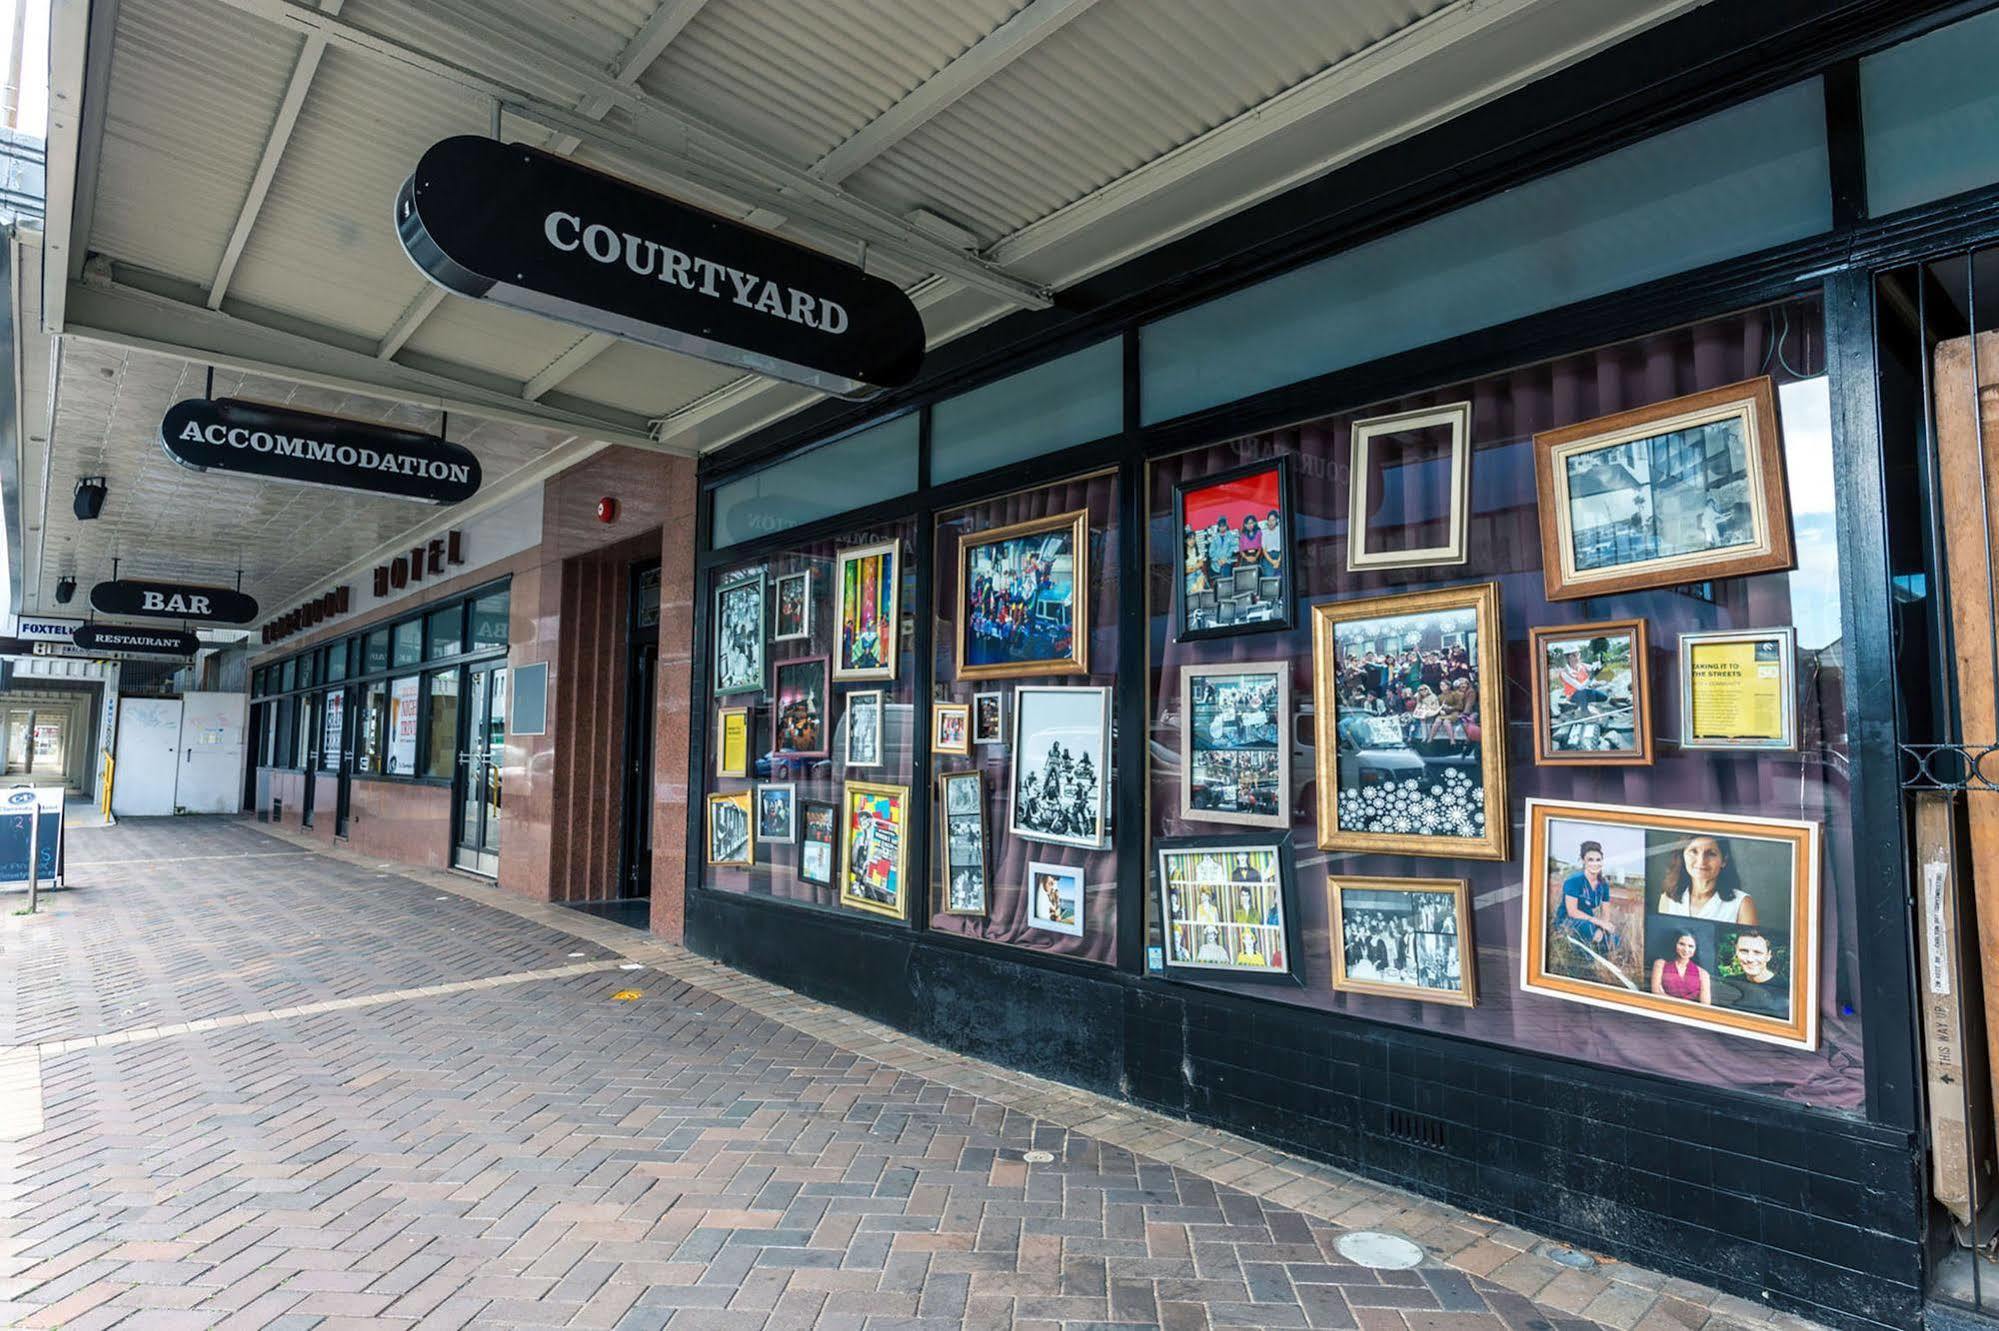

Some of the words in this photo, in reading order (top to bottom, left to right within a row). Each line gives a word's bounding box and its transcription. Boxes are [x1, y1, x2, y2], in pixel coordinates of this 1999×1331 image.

[544, 210, 849, 336] COURTYARD
[179, 420, 471, 485] ACCOMMODATION
[142, 591, 212, 615] BAR
[22, 623, 68, 635] FOXTEL
[95, 634, 181, 648] RESTAURANT
[1935, 1005, 1946, 1020] UP
[1936, 1022, 1949, 1042] WAY
[1937, 1046, 1951, 1066] THIS
